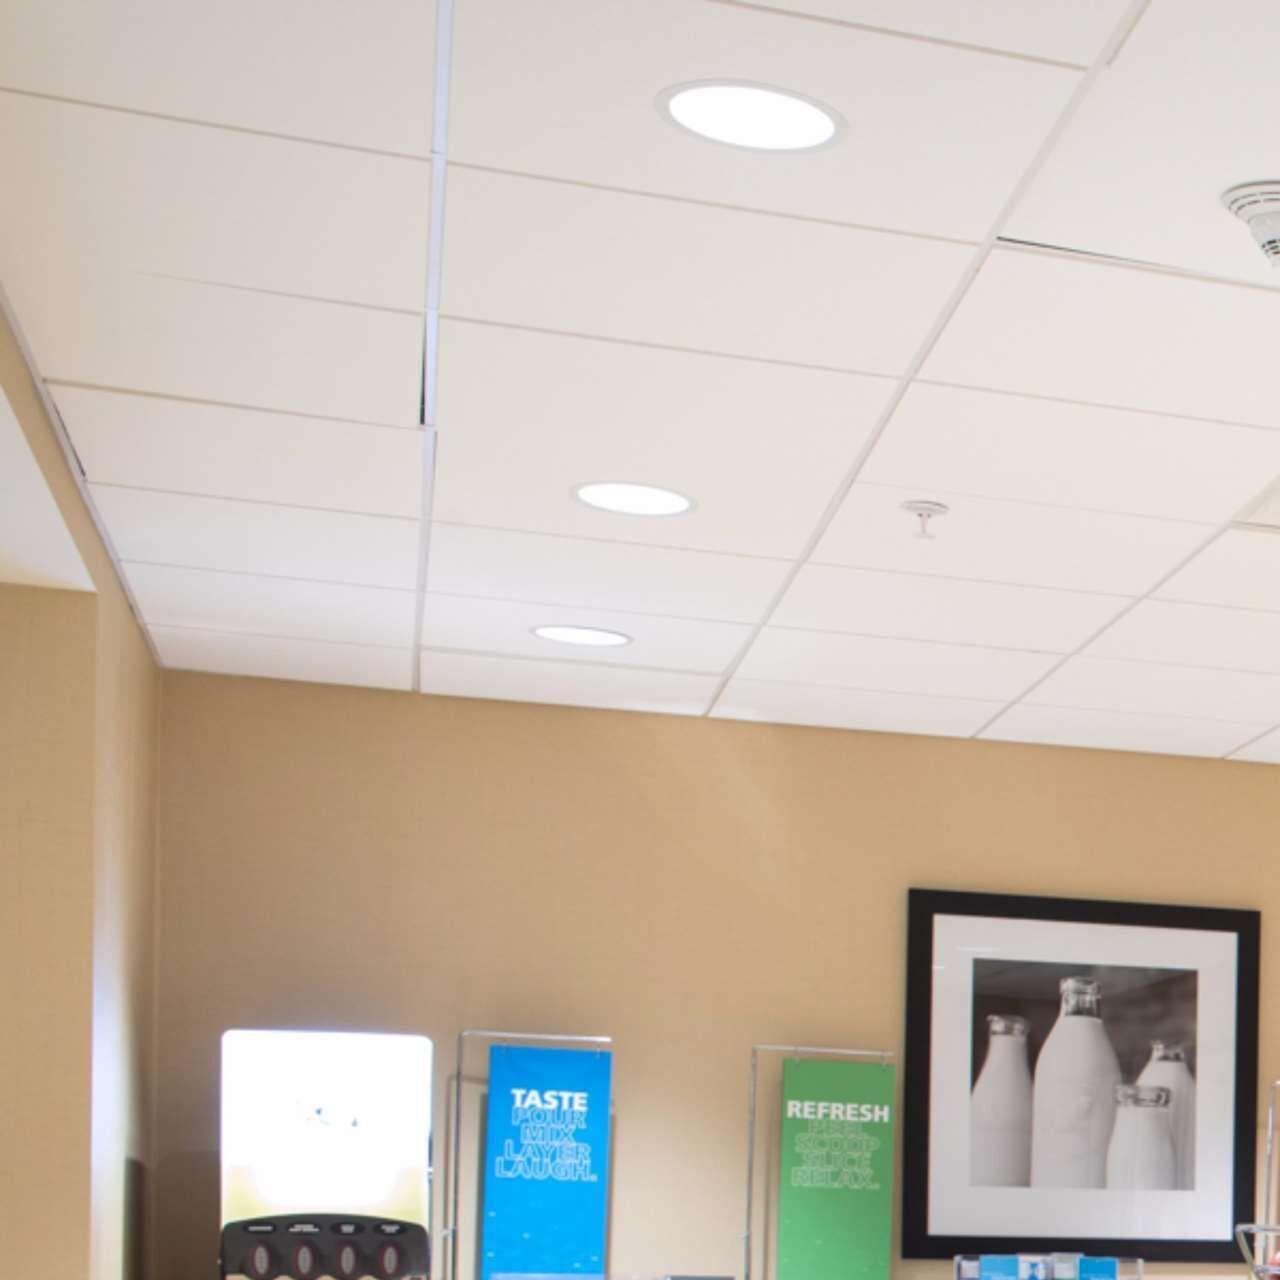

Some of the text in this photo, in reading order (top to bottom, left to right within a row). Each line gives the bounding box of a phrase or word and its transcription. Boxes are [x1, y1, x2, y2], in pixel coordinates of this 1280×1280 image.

[511, 1088, 588, 1111] TASTE
[512, 1107, 587, 1129] POUR
[787, 1100, 890, 1123] REFRESH
[521, 1123, 577, 1144] MIX
[795, 1133, 881, 1154] SCOOP
[504, 1139, 591, 1162] LAYER
[803, 1152, 871, 1170] SLICE
